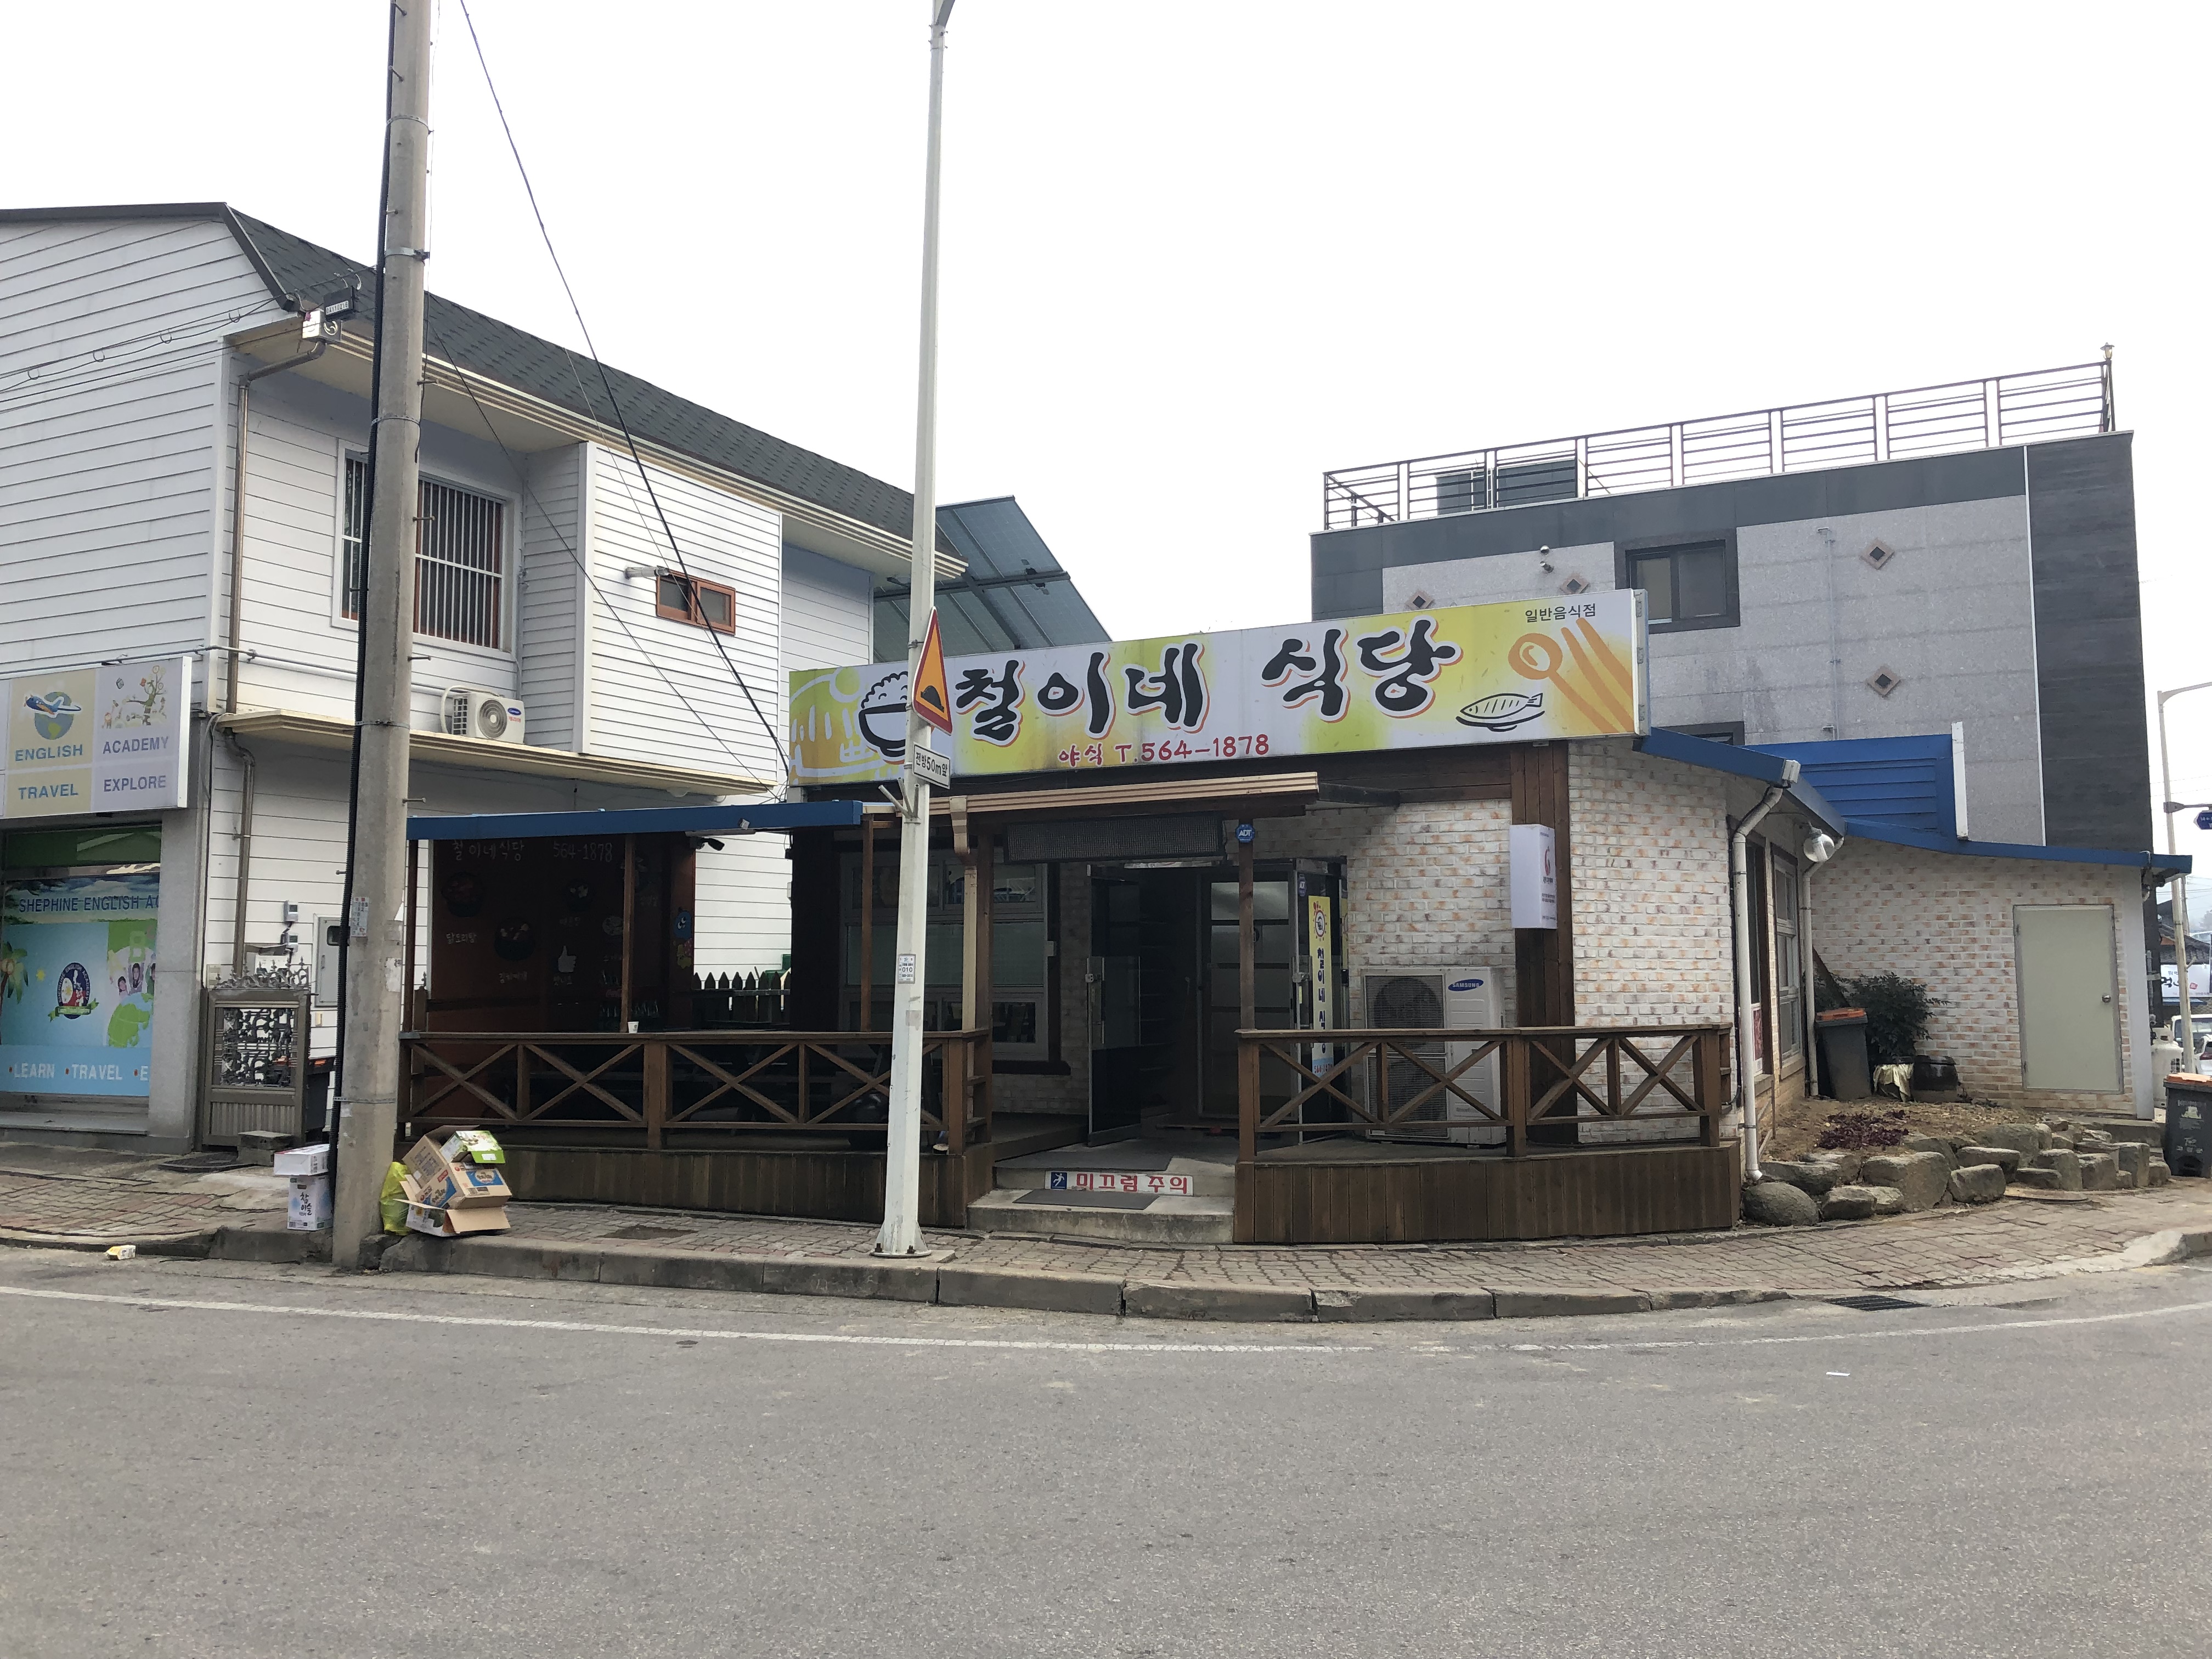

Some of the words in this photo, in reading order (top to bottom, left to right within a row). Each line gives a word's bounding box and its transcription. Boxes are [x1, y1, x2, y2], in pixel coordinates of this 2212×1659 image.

[1525, 603, 1595, 623] 일반음식점
[955, 643, 1201, 741] 철이네
[1261, 619, 1455, 716] 식당
[15, 744, 83, 762] ENGLISH
[102, 736, 169, 755] ACADEMY
[1059, 743, 1103, 766] 야식
[916, 752, 948, 777] 전방50m앞
[18, 783, 78, 799] TRAVEL
[104, 775, 166, 792] EXPLORE
[452, 839, 496, 861] 철이네
[500, 839, 524, 861] 식당
[553, 842, 612, 862] 564-1878
[19, 898, 78, 912] SHEPHINE
[84, 895, 139, 911] ENGLISH
[14, 1062, 55, 1079] LEARN
[71, 1063, 123, 1080] TRAVEL
[1076, 1173, 1138, 1193] 미끄럼
[1148, 1175, 1188, 1195] 주의
